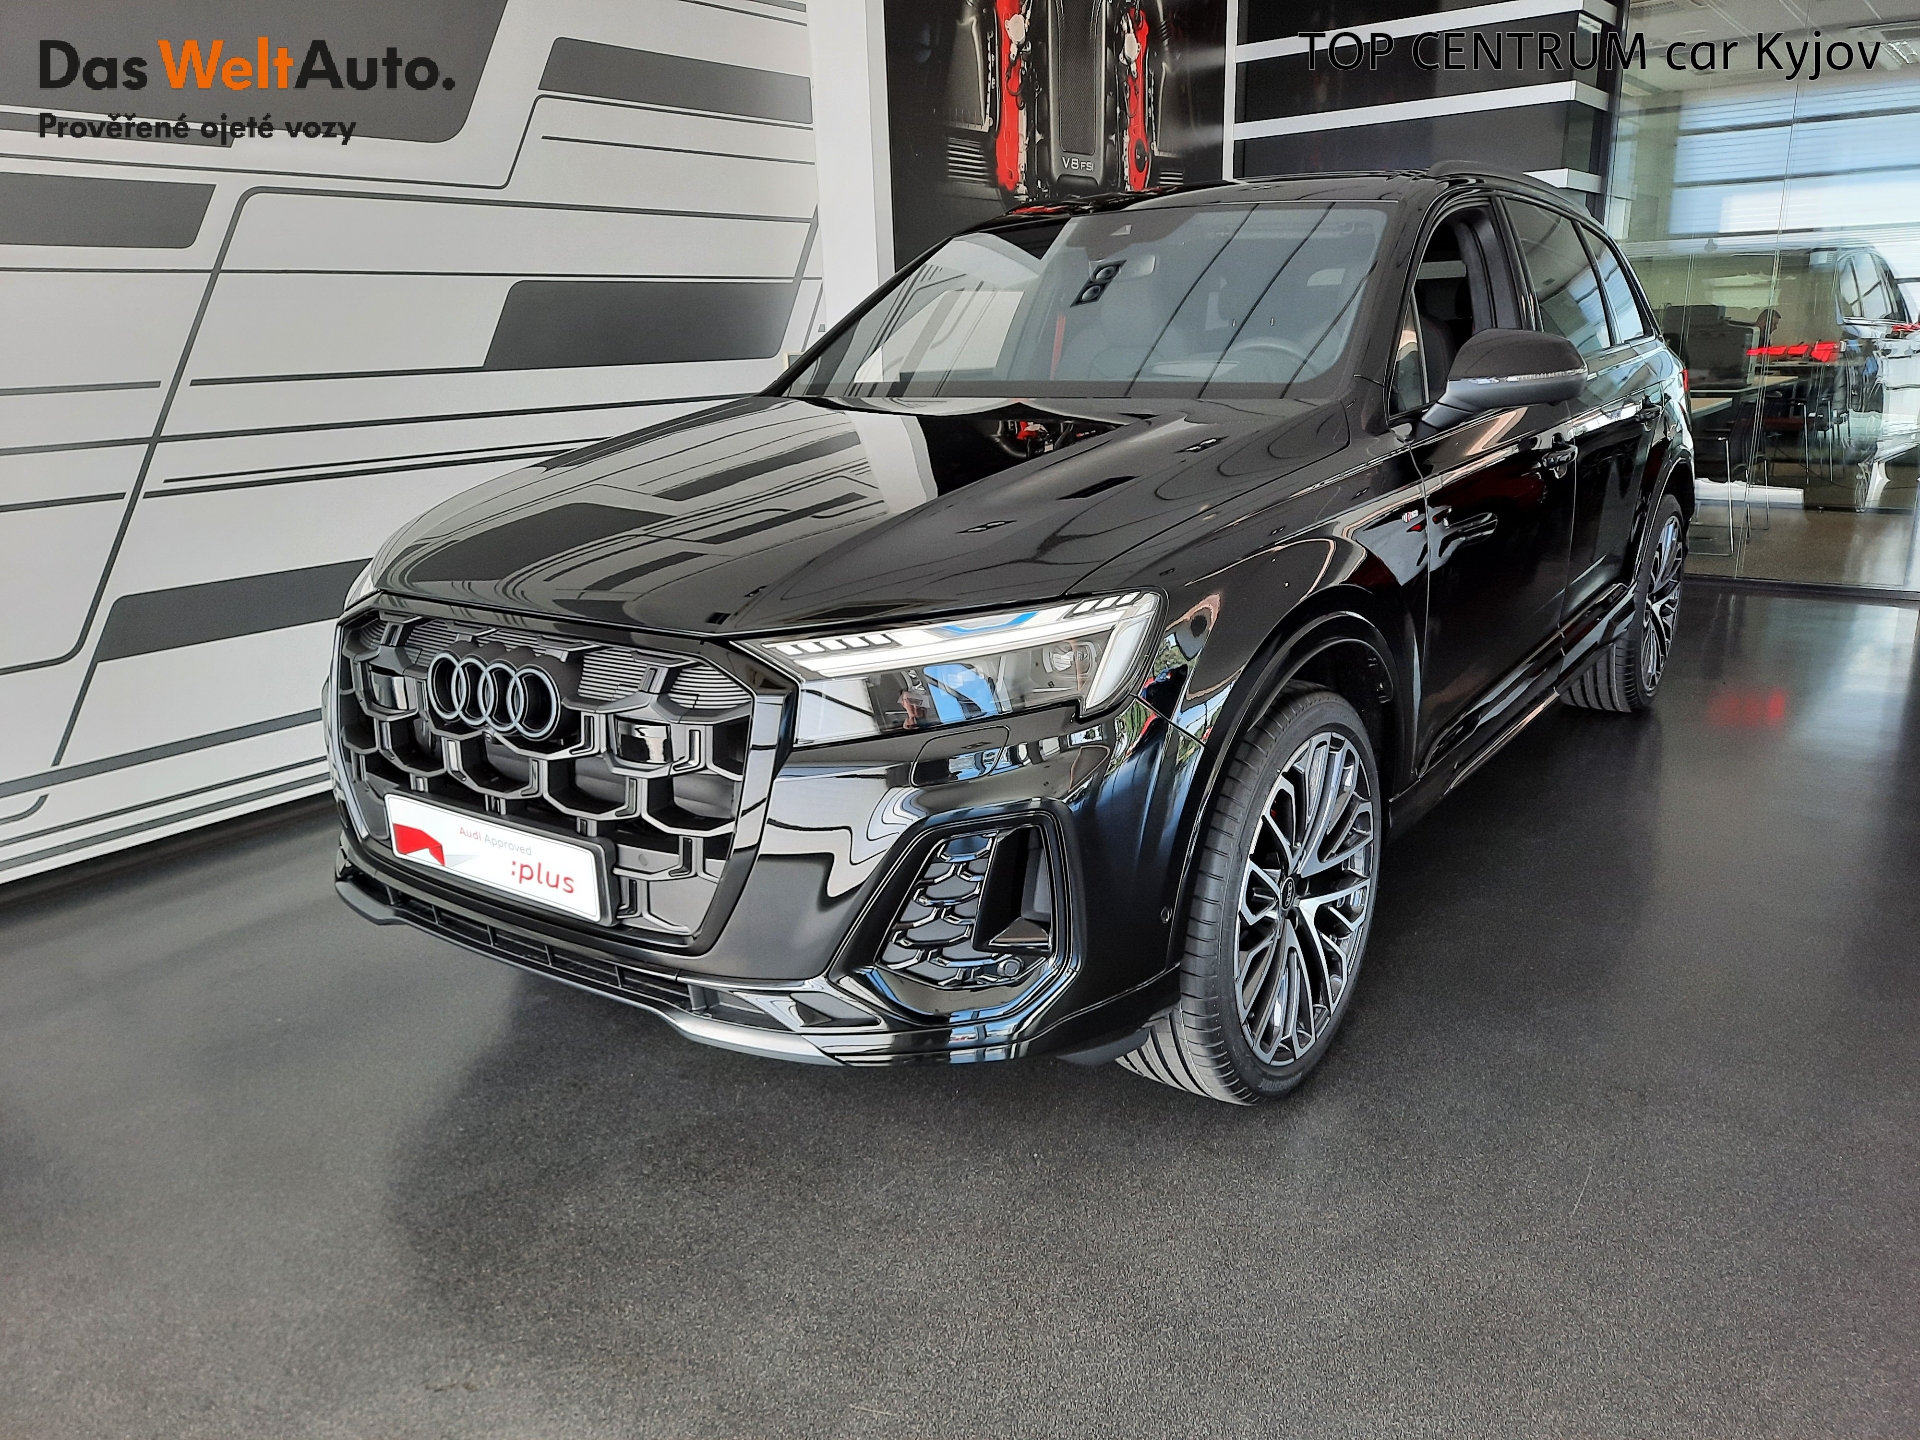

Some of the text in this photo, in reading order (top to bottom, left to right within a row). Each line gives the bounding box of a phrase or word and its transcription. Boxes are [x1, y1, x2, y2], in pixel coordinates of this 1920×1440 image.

[1062, 156, 1079, 170] V8
[459, 827, 532, 855] Audi Approved
[511, 860, 575, 894] :plus
